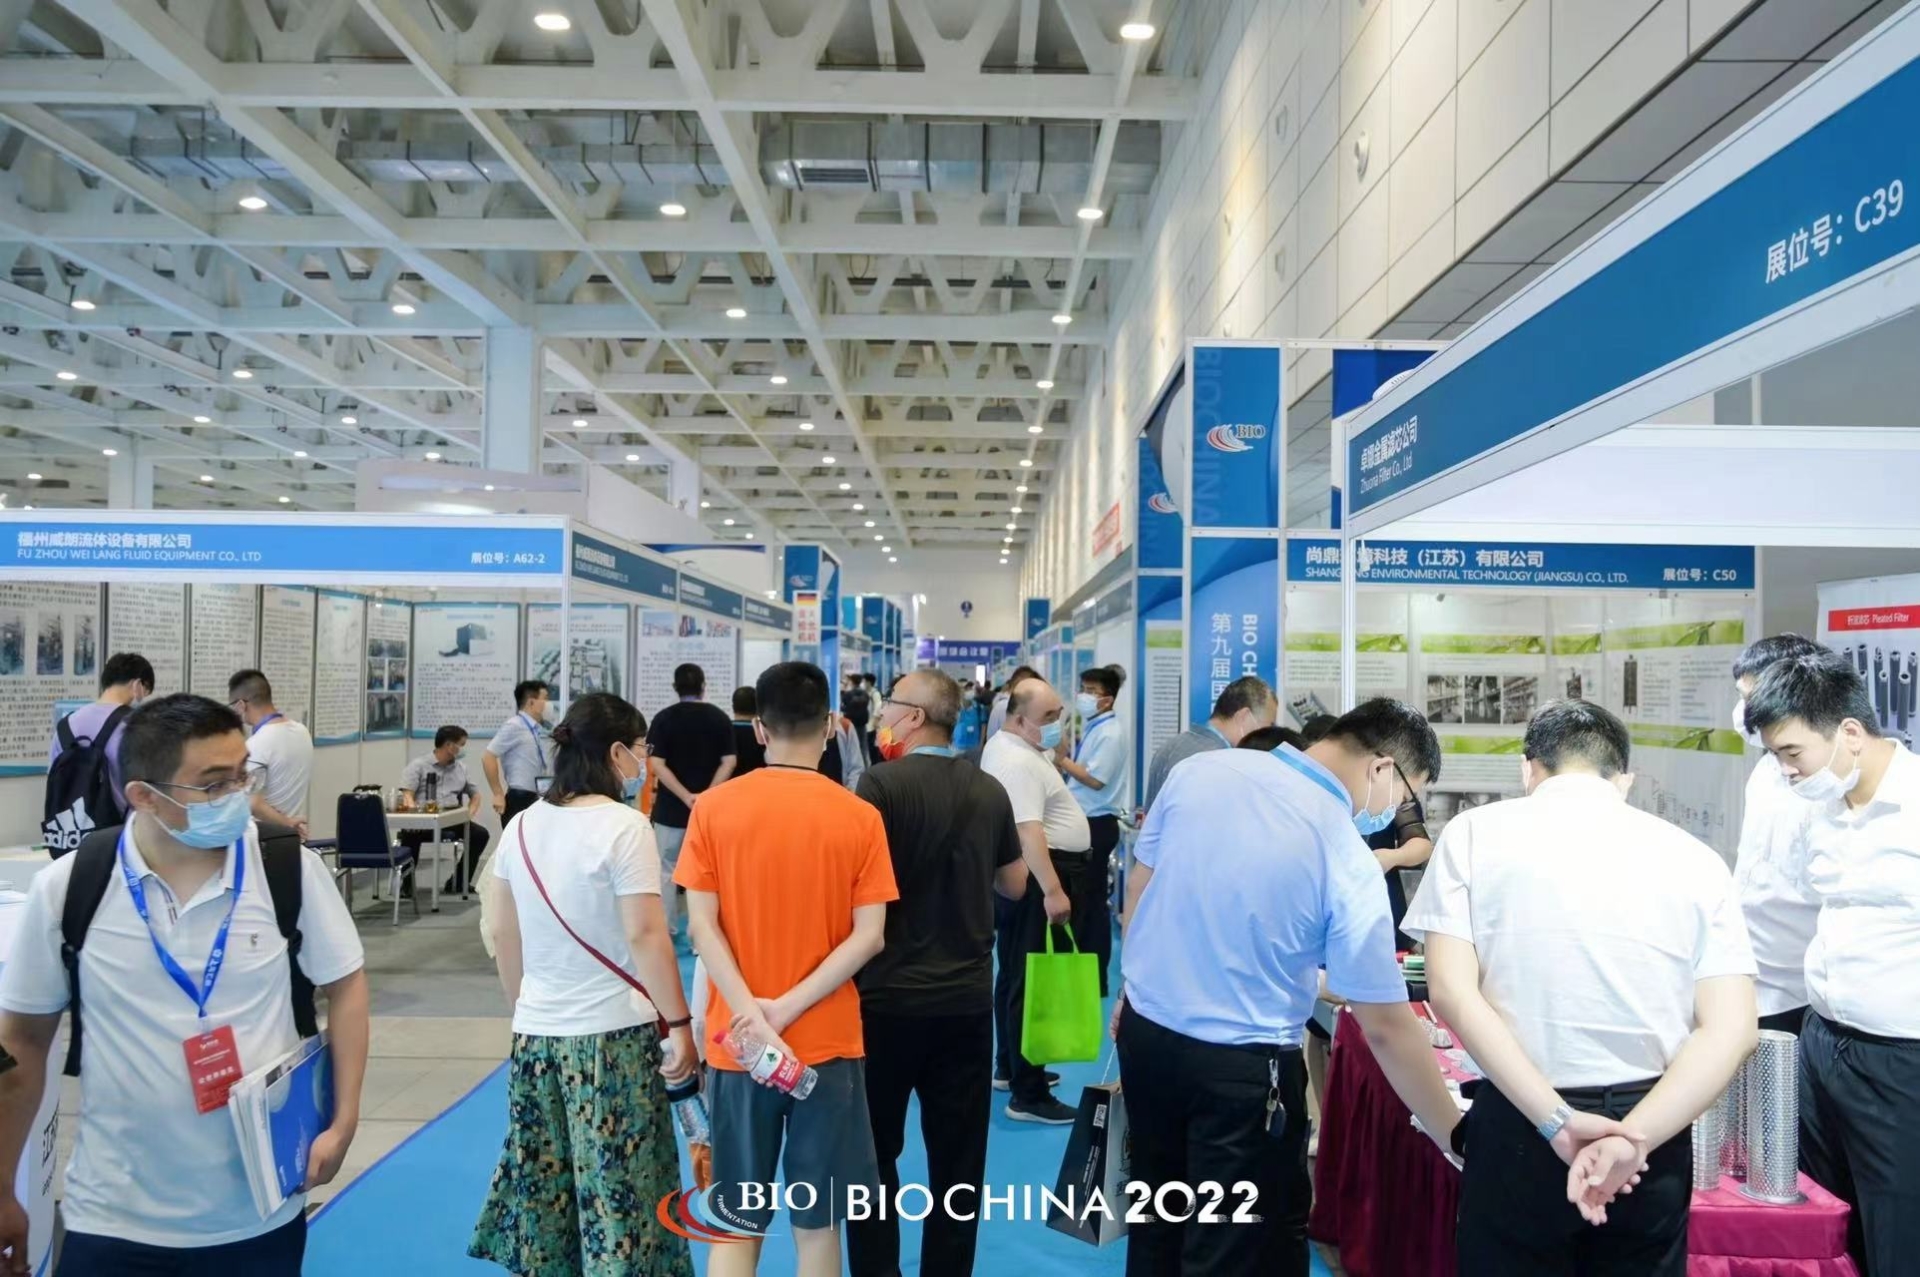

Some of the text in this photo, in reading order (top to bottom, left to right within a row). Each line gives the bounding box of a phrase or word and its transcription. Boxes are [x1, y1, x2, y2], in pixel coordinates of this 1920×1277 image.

[1236, 424, 1266, 439] BIO
[1379, 467, 1392, 483] Filter
[17, 549, 32, 559] FU
[35, 549, 68, 559] ZHOU
[70, 549, 91, 560] WEI
[93, 550, 121, 560] LANG
[124, 550, 152, 561] FLUID
[154, 550, 216, 562] EQUIPMENT
[242, 551, 262, 562] LTD
[1305, 546, 1544, 567] 尚鼎境科技（江苏）有限公司
[1371, 569, 1460, 580] ENVIRONMENTAL
[1463, 570, 1532, 582] TECHNOLOGY
[1534, 571, 1584, 584] (JIANGSU)
[1608, 572, 1630, 583] LTD.
[1894, 612, 1910, 622] Filter
[1242, 614, 1258, 645] BIO
